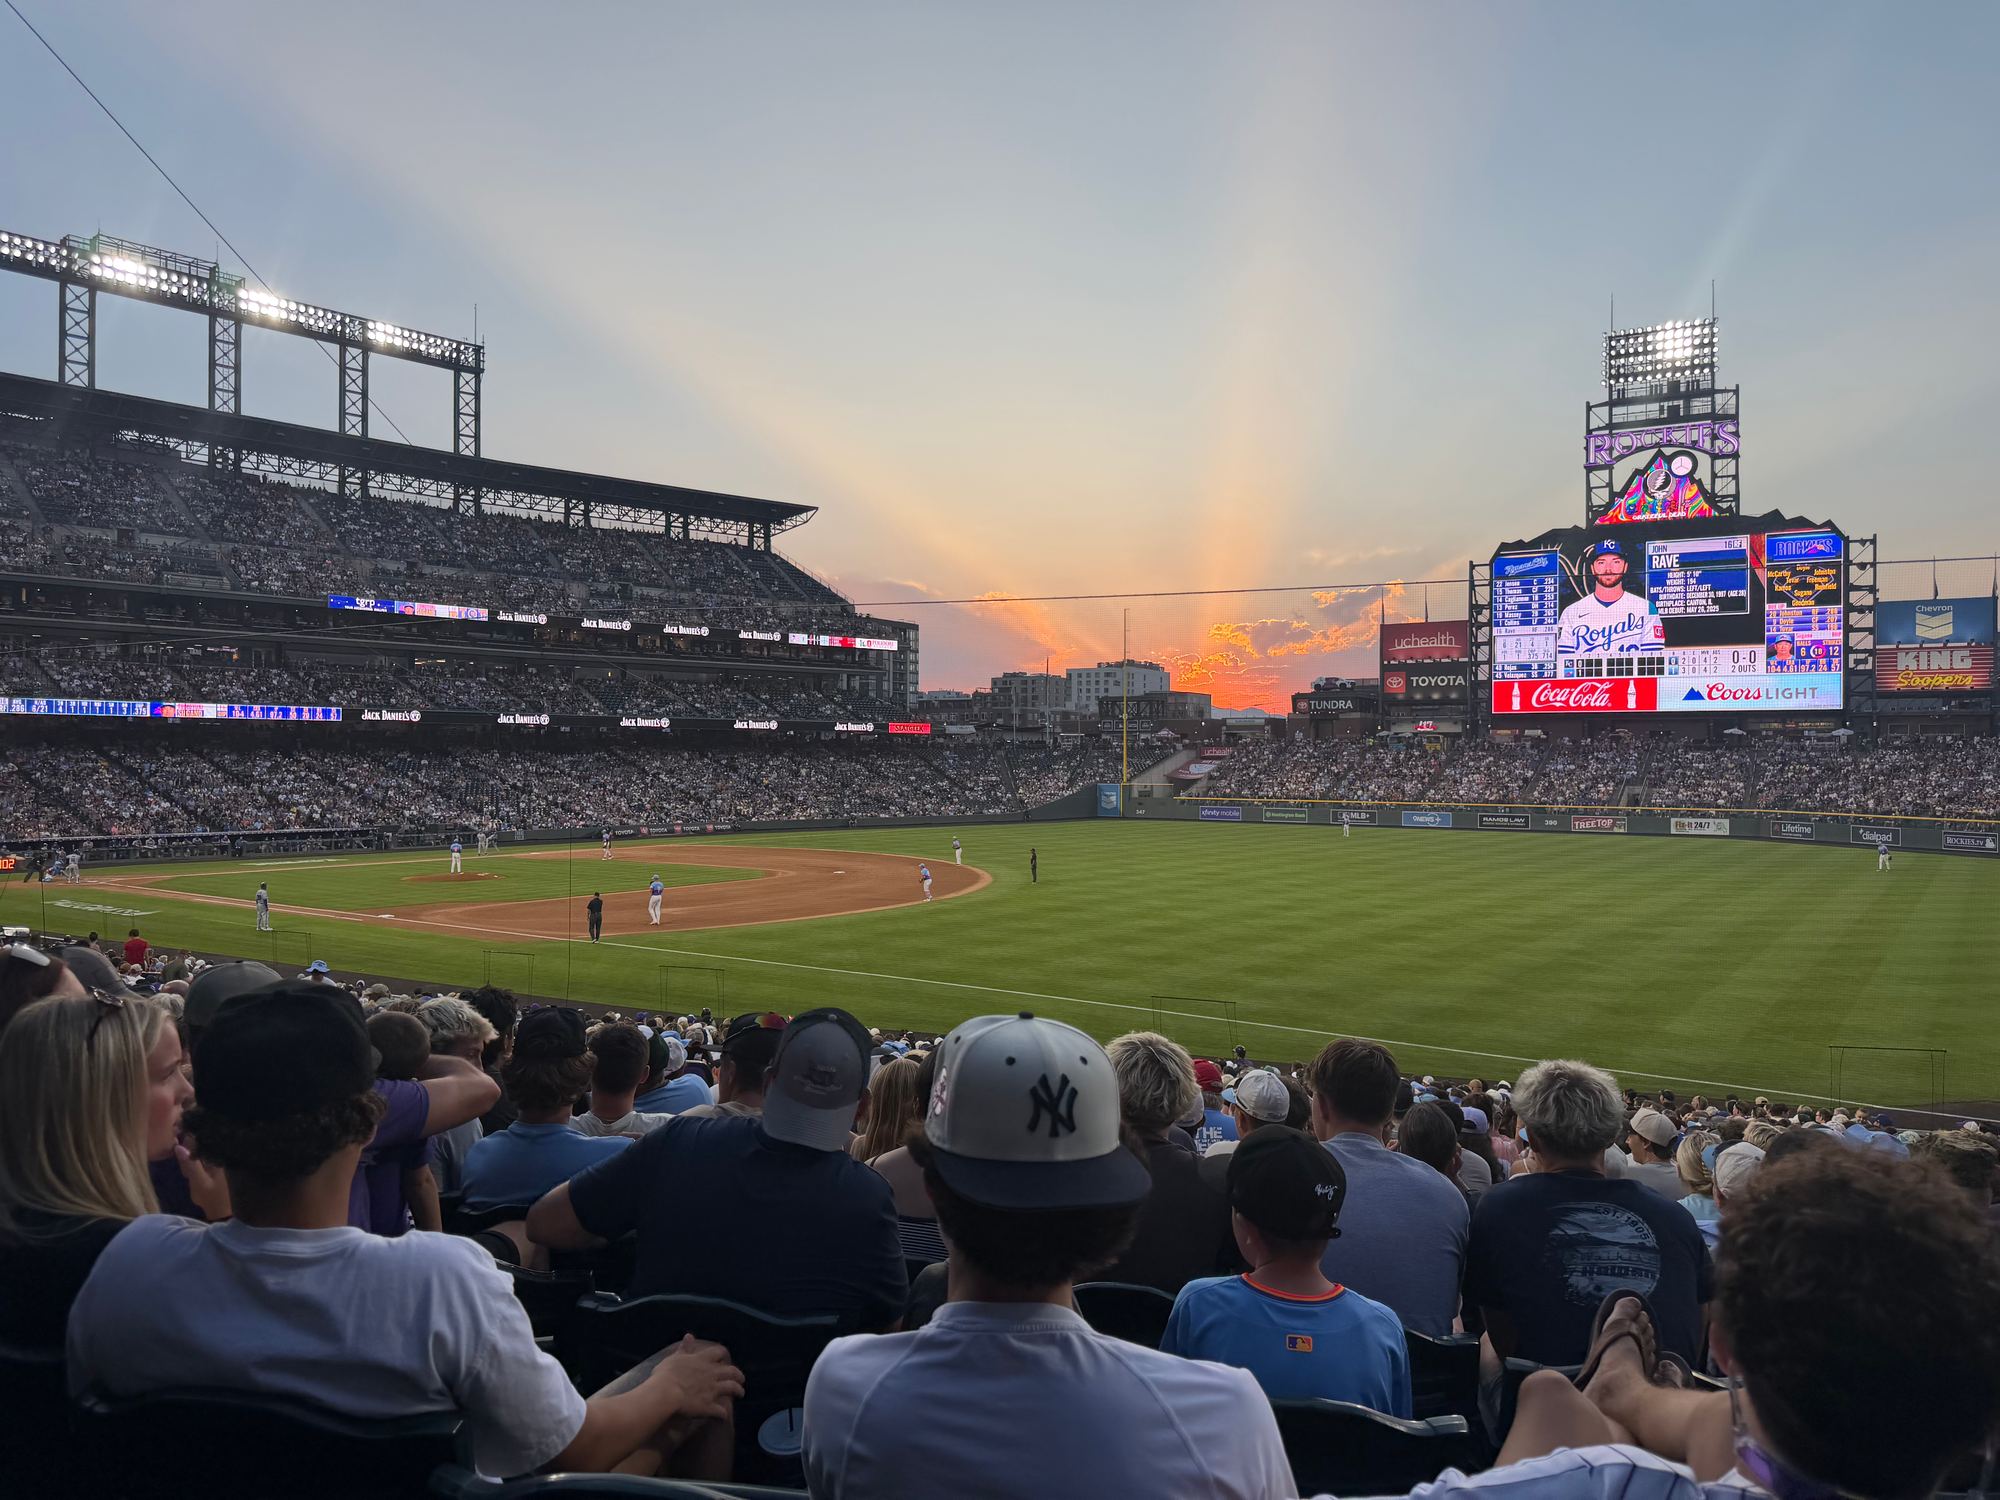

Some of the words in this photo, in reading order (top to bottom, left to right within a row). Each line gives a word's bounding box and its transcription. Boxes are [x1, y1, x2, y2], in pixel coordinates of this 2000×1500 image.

[1584, 420, 1740, 468] ROCKIES
[1652, 545, 1668, 553] JOHN
[1774, 539, 1836, 556] ROCKIES
[1652, 554, 1680, 568] RAVE
[356, 597, 375, 608] tgrp
[497, 611, 513, 621] JACK
[581, 618, 597, 628] JACK
[663, 624, 678, 634] JACK
[739, 630, 752, 639] JACK
[1572, 613, 1644, 651] Royals
[1395, 632, 1455, 648] uchealth
[1800, 648, 1806, 656] 6
[1829, 646, 1839, 656] 12
[1897, 650, 1972, 670] KING
[1411, 675, 1465, 687] TOYOTA
[1896, 670, 1973, 690] Soopers
[1532, 682, 1614, 708] Coca-Cola
[1706, 682, 1762, 701] Coors
[1766, 687, 1818, 699] LIGHT
[1310, 700, 1353, 710] TUNDRA
[362, 709, 380, 720] JACK
[498, 714, 514, 723] JACK
[620, 717, 636, 727] JACK
[734, 719, 748, 729] JACK
[835, 722, 847, 731] JACK
[1694, 822, 1710, 830] 24/7
[1782, 824, 1812, 833] Lifetime
[1862, 831, 1892, 842] dialpad
[1026, 1074, 1078, 1138] NY
